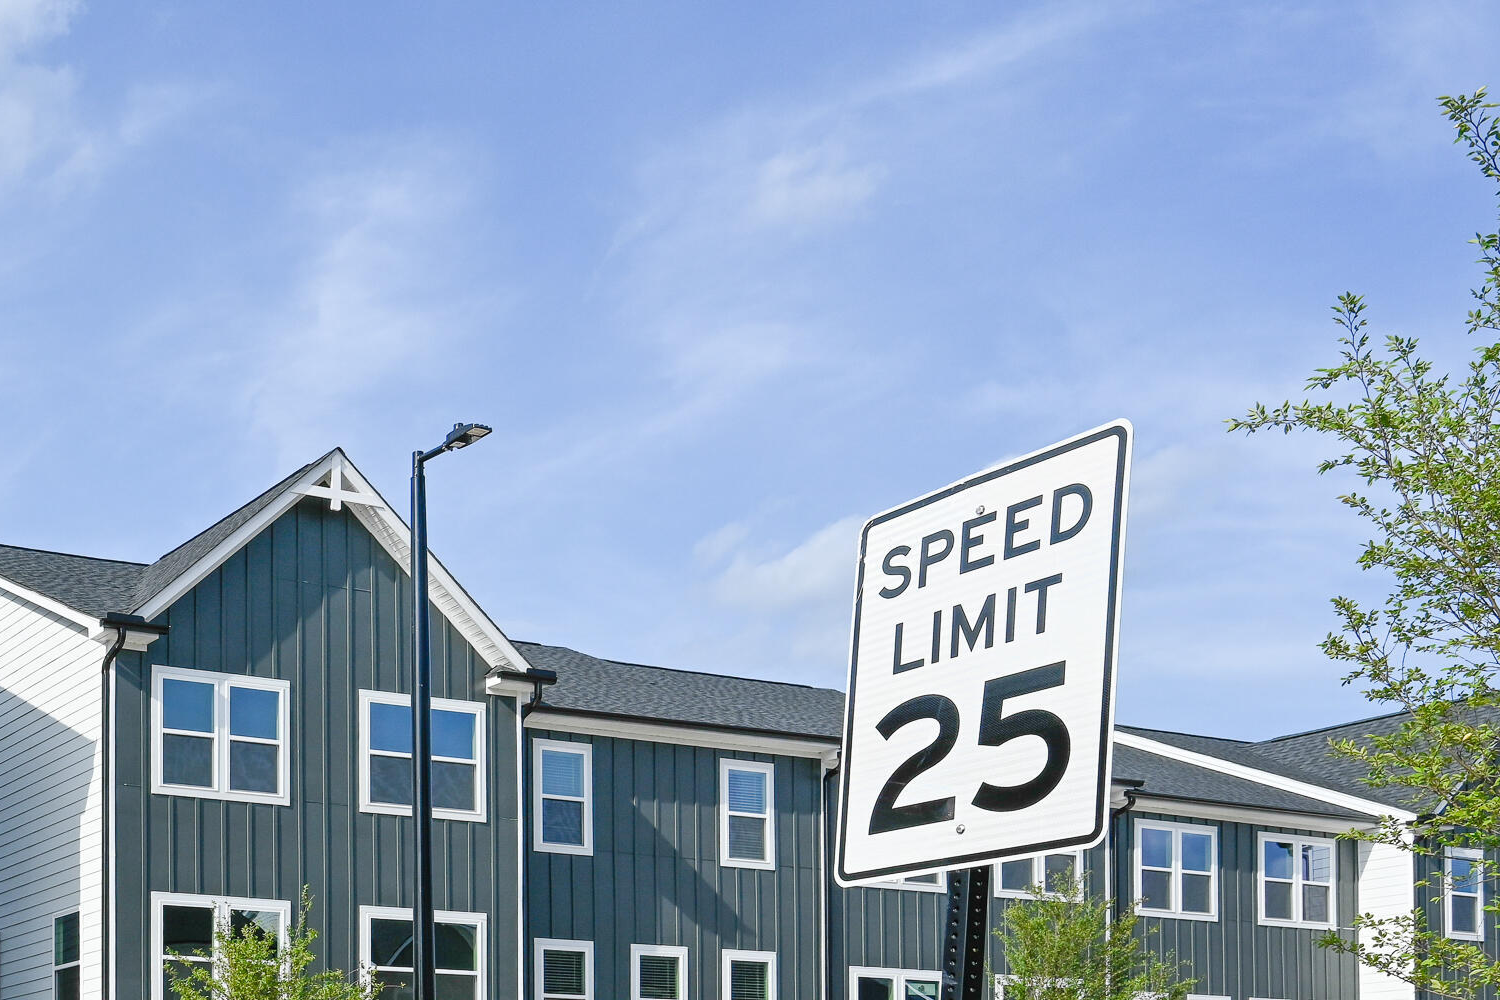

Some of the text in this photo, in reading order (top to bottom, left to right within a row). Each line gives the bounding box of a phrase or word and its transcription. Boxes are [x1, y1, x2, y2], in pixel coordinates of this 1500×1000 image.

[878, 483, 1093, 599] SPEED
[893, 573, 1062, 675] LIMIT
[868, 660, 1071, 835] 25
